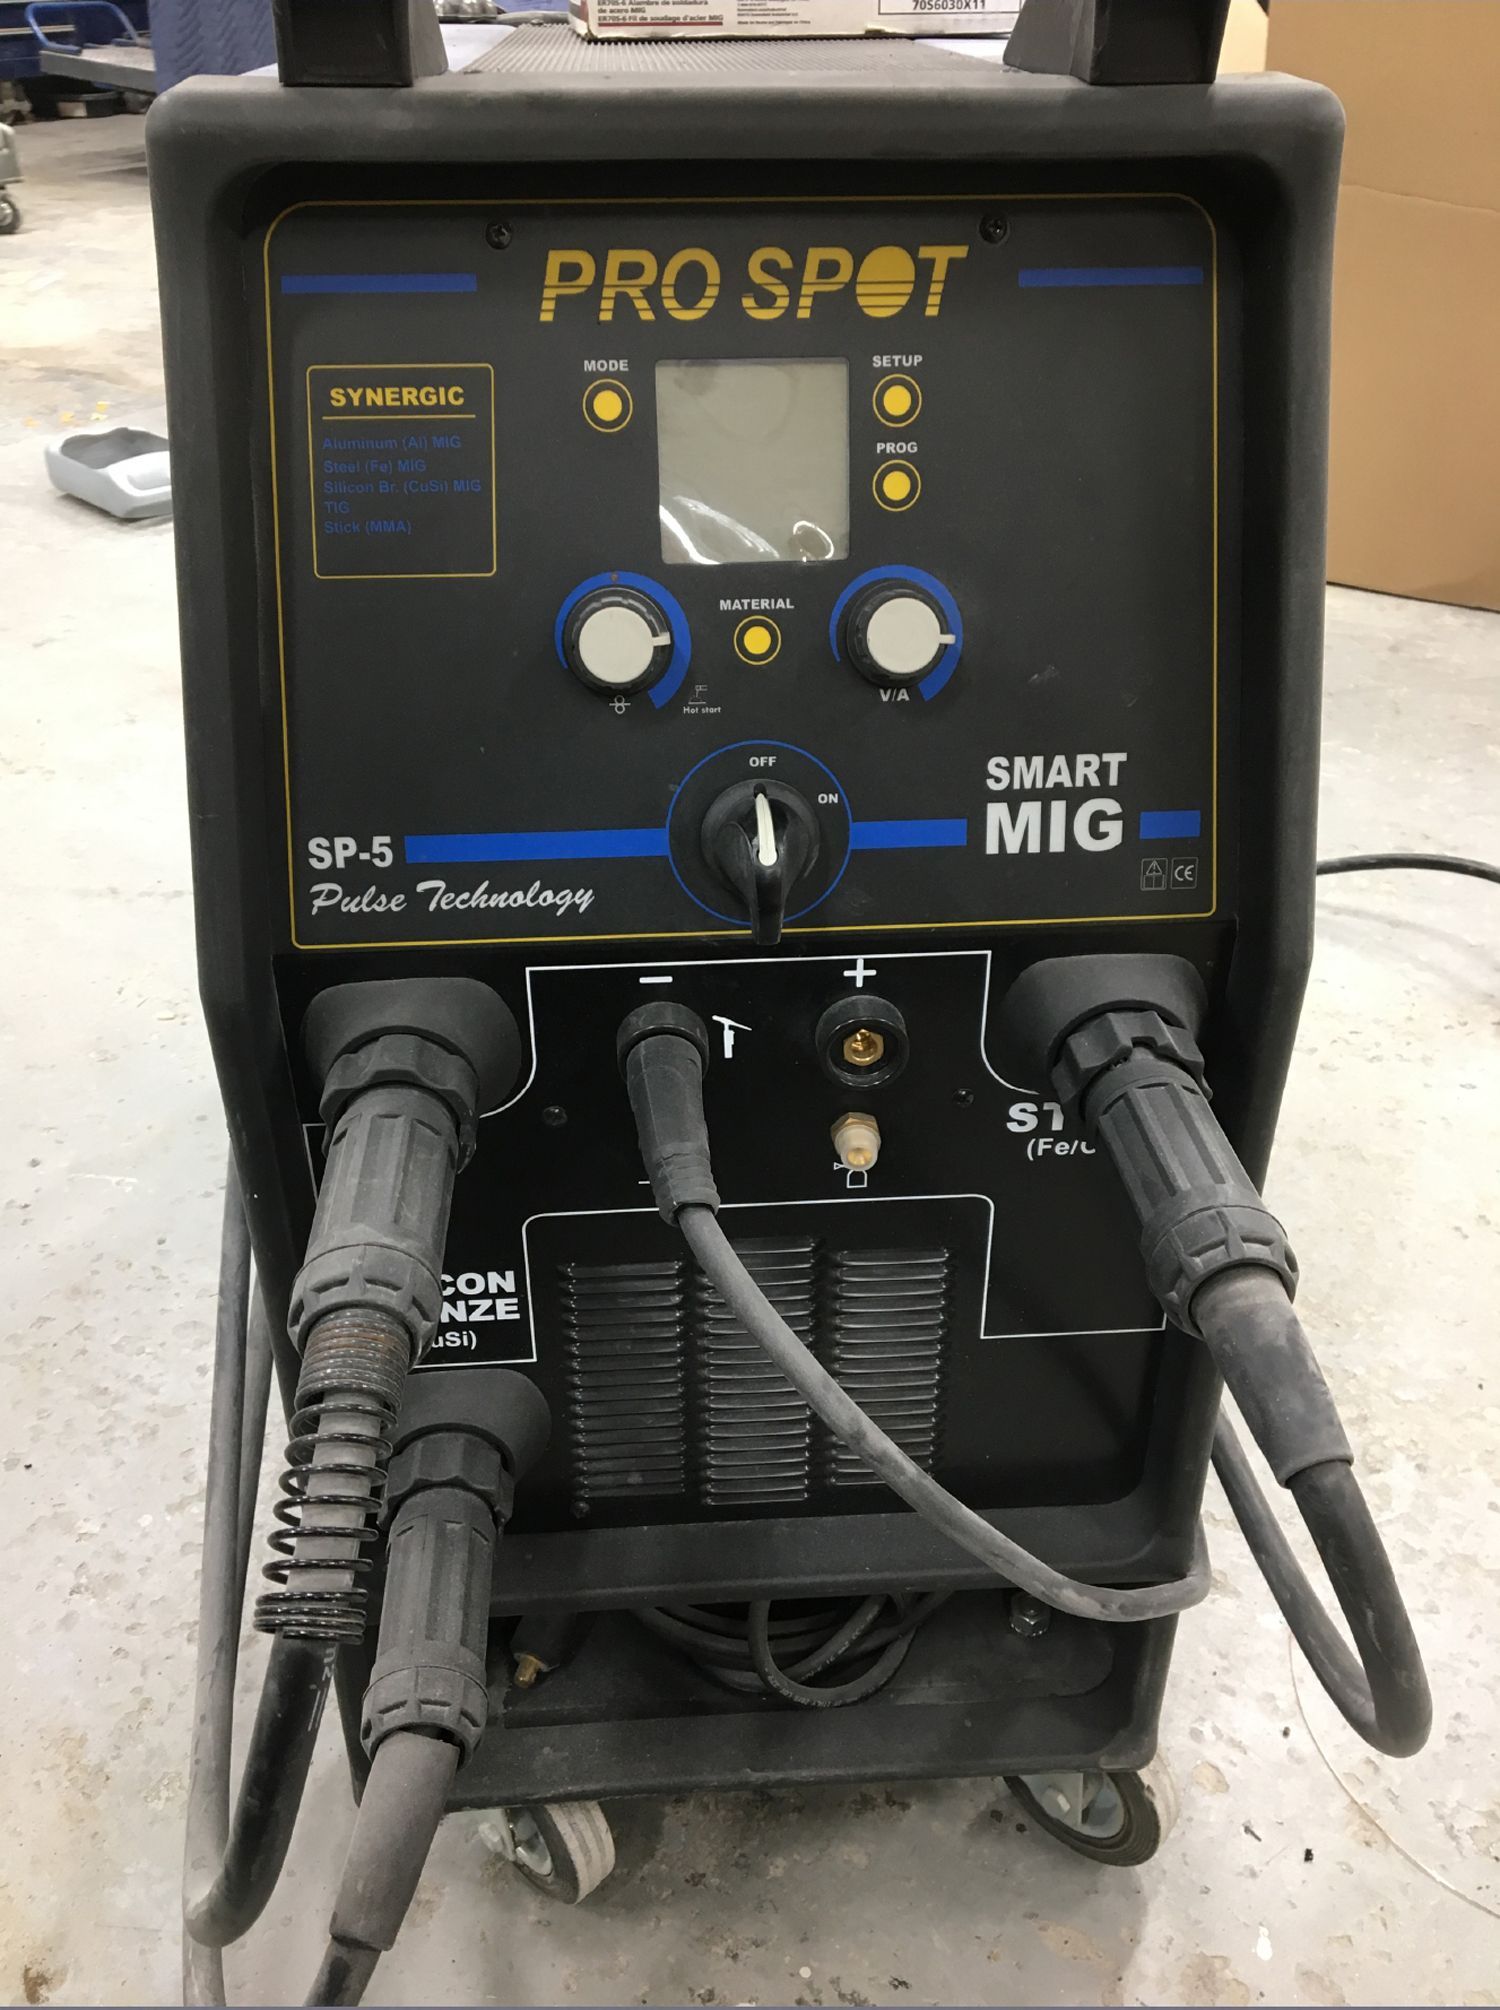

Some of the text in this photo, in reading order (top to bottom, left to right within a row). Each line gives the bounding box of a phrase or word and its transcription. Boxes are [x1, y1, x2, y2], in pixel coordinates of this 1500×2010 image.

[539, 246, 969, 322] PRO SPOT
[583, 359, 629, 372] MODE
[872, 354, 923, 368] SETUP
[329, 386, 465, 407] SYNERGIC
[323, 436, 398, 450] Aluminum
[432, 435, 462, 448] MIG
[876, 441, 918, 454] PROG
[323, 459, 427, 475] Steel (Fe) MIG
[323, 480, 374, 494] Silicon
[403, 480, 449, 495] (CuSi)
[453, 480, 482, 493] MIG
[324, 500, 350, 514] TIG
[323, 520, 412, 535] Stick (MMA)
[719, 597, 795, 611] MATERIAL
[879, 688, 910, 702] V/A
[683, 706, 722, 714] Hot start
[748, 755, 777, 768] OFF
[985, 752, 1128, 791] SMART
[817, 792, 839, 804] ON
[985, 797, 1124, 855] MIG
[307, 835, 394, 870] SP-5
[309, 879, 595, 917] Pulse Technology
[1006, 1102, 1065, 1133] ST
[440, 1270, 516, 1296] CON
[440, 1297, 521, 1323] NZE
[431, 1330, 477, 1350] uSi)
